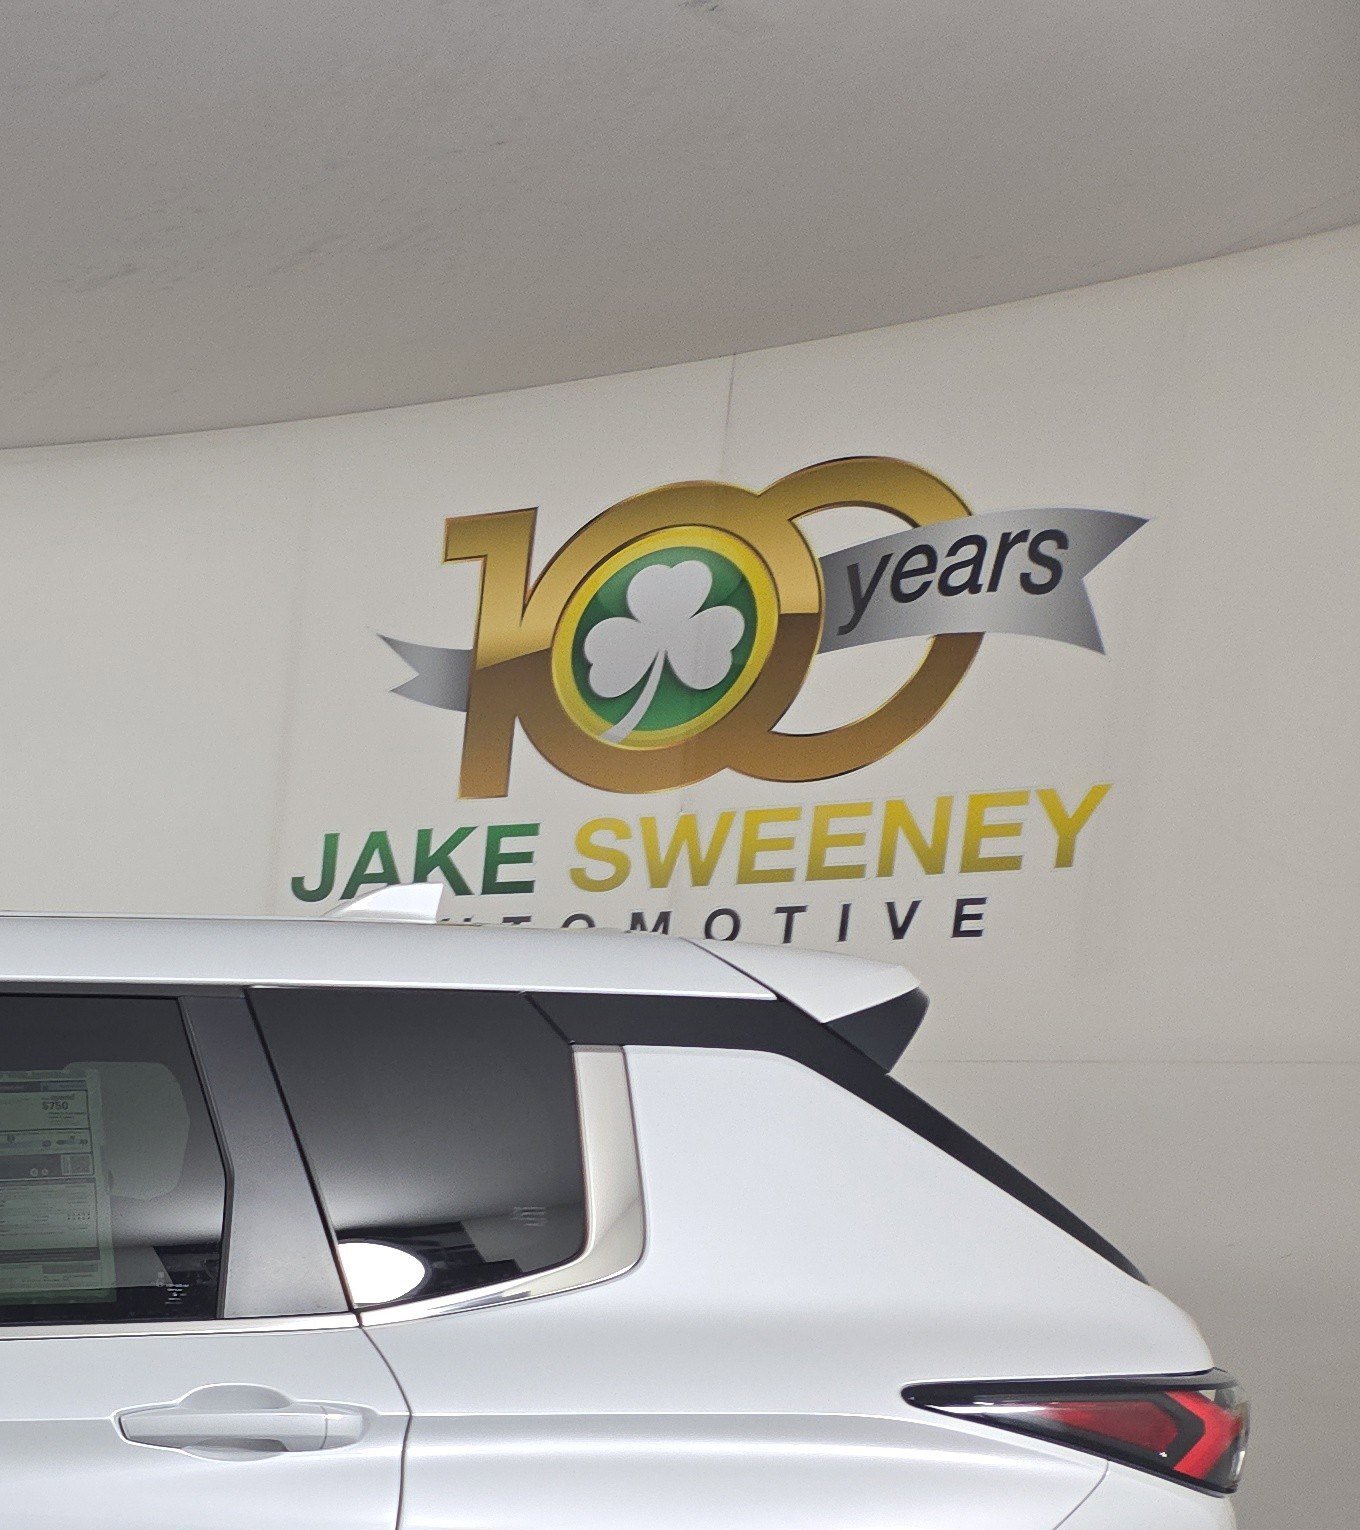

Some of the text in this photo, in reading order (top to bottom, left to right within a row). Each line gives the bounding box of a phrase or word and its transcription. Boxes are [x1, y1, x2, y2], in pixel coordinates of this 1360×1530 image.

[442, 456, 1070, 799] 100 years
[291, 784, 1114, 903] JAKE SWEENEY
